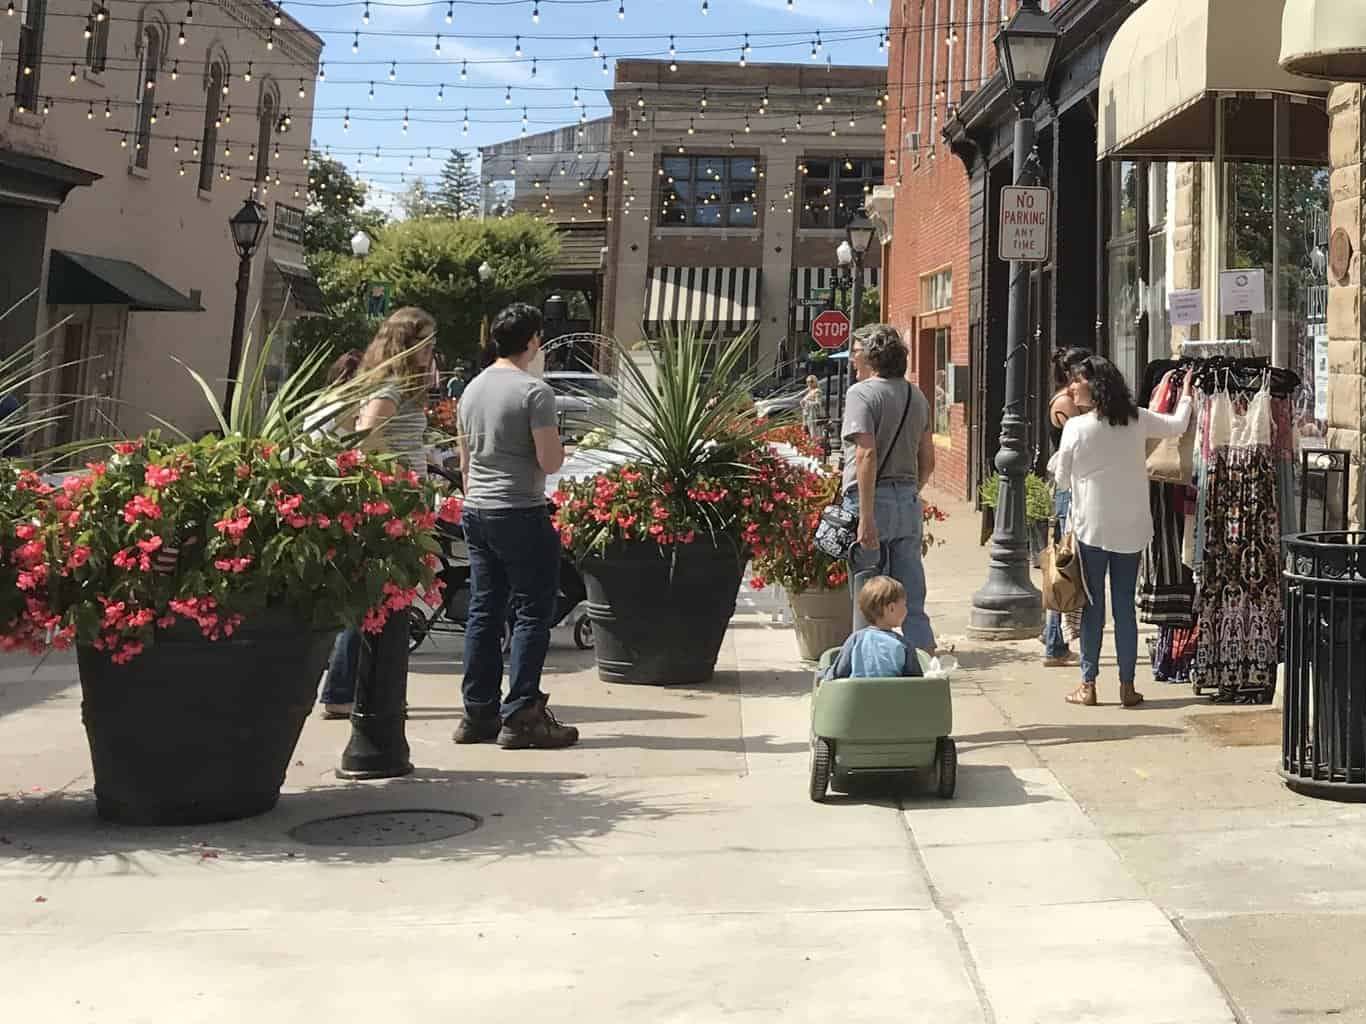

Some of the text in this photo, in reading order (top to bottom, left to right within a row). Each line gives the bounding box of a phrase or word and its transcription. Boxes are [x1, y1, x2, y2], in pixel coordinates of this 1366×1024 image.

[1016, 194, 1034, 208] NO
[1004, 210, 1045, 225] PARKING
[1015, 228, 1034, 237] ANY
[1013, 240, 1036, 250] TIME
[815, 322, 848, 337] STOP
